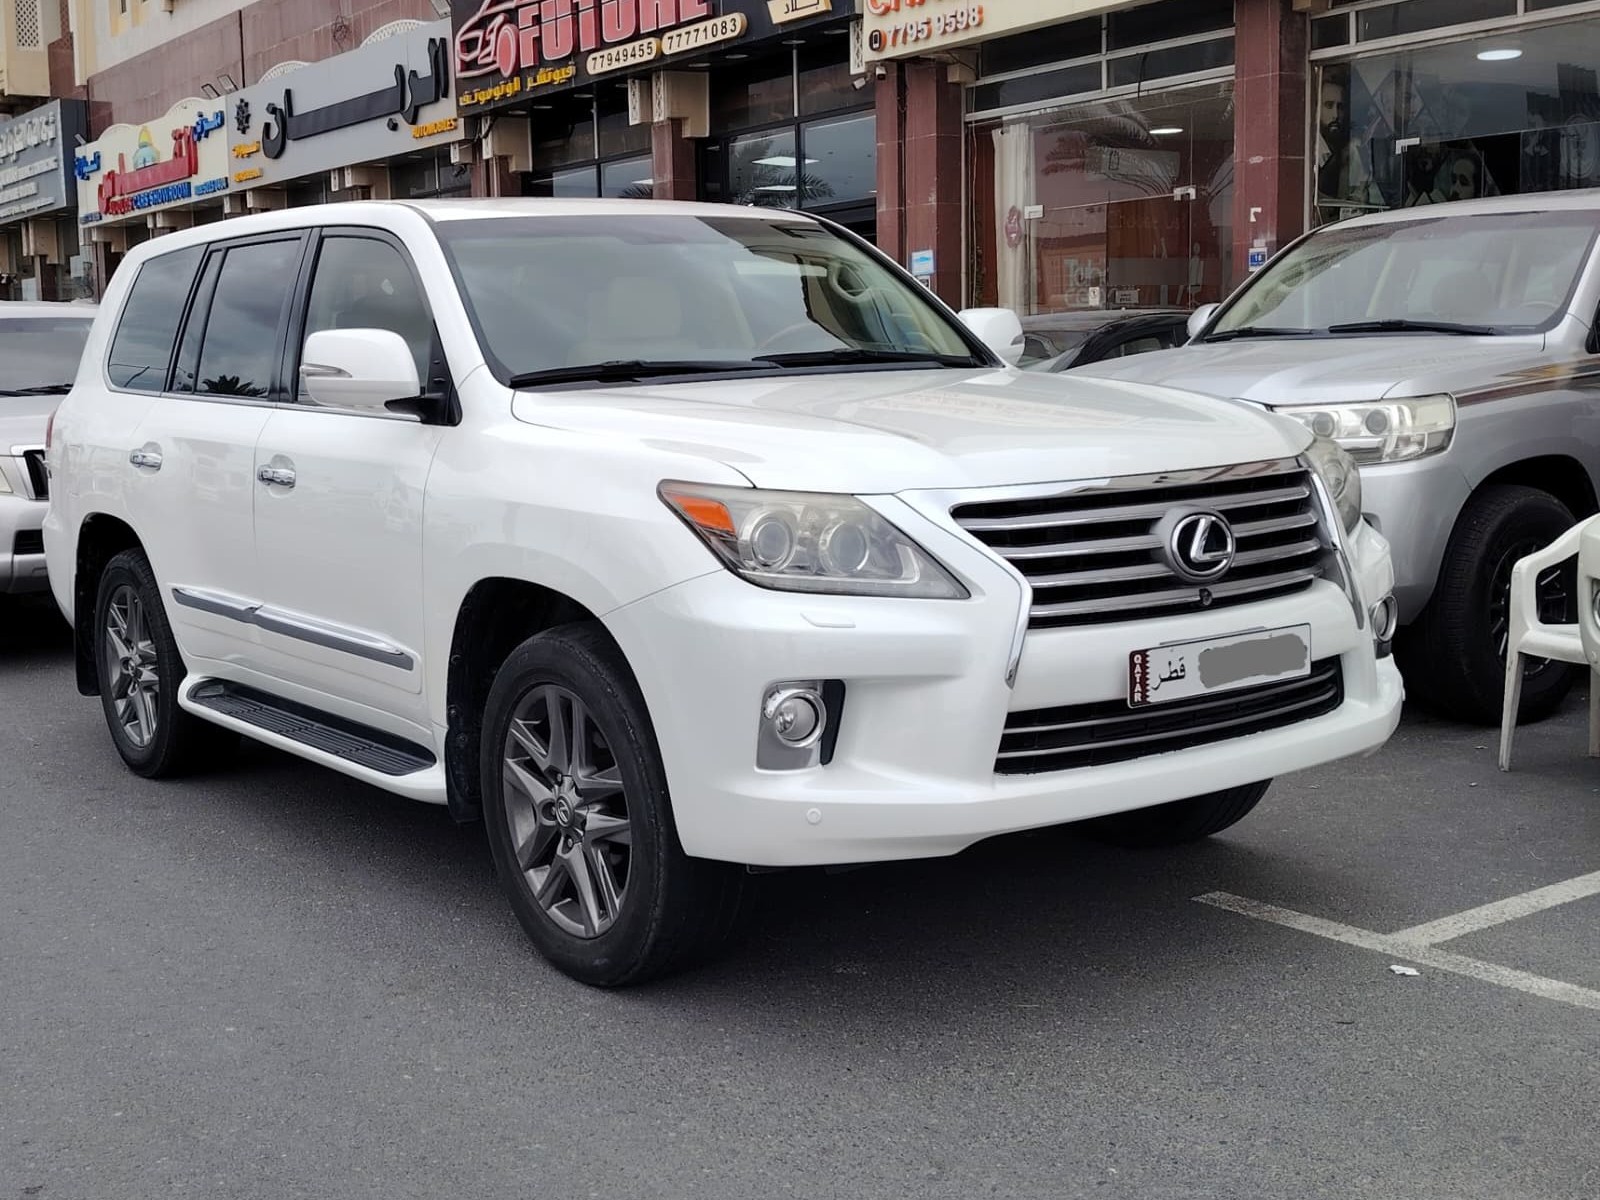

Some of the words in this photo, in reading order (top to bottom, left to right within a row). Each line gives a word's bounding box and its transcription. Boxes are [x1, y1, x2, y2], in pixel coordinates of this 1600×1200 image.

[667, 17, 738, 51] 77771083
[889, 17, 932, 47] 7795
[936, 4, 983, 36] 9598
[591, 41, 654, 71] 77949455
[411, 117, 458, 139] AUTOMOBILES
[149, 180, 192, 207] SHOWROOM
[1133, 654, 1142, 702] QATAR
